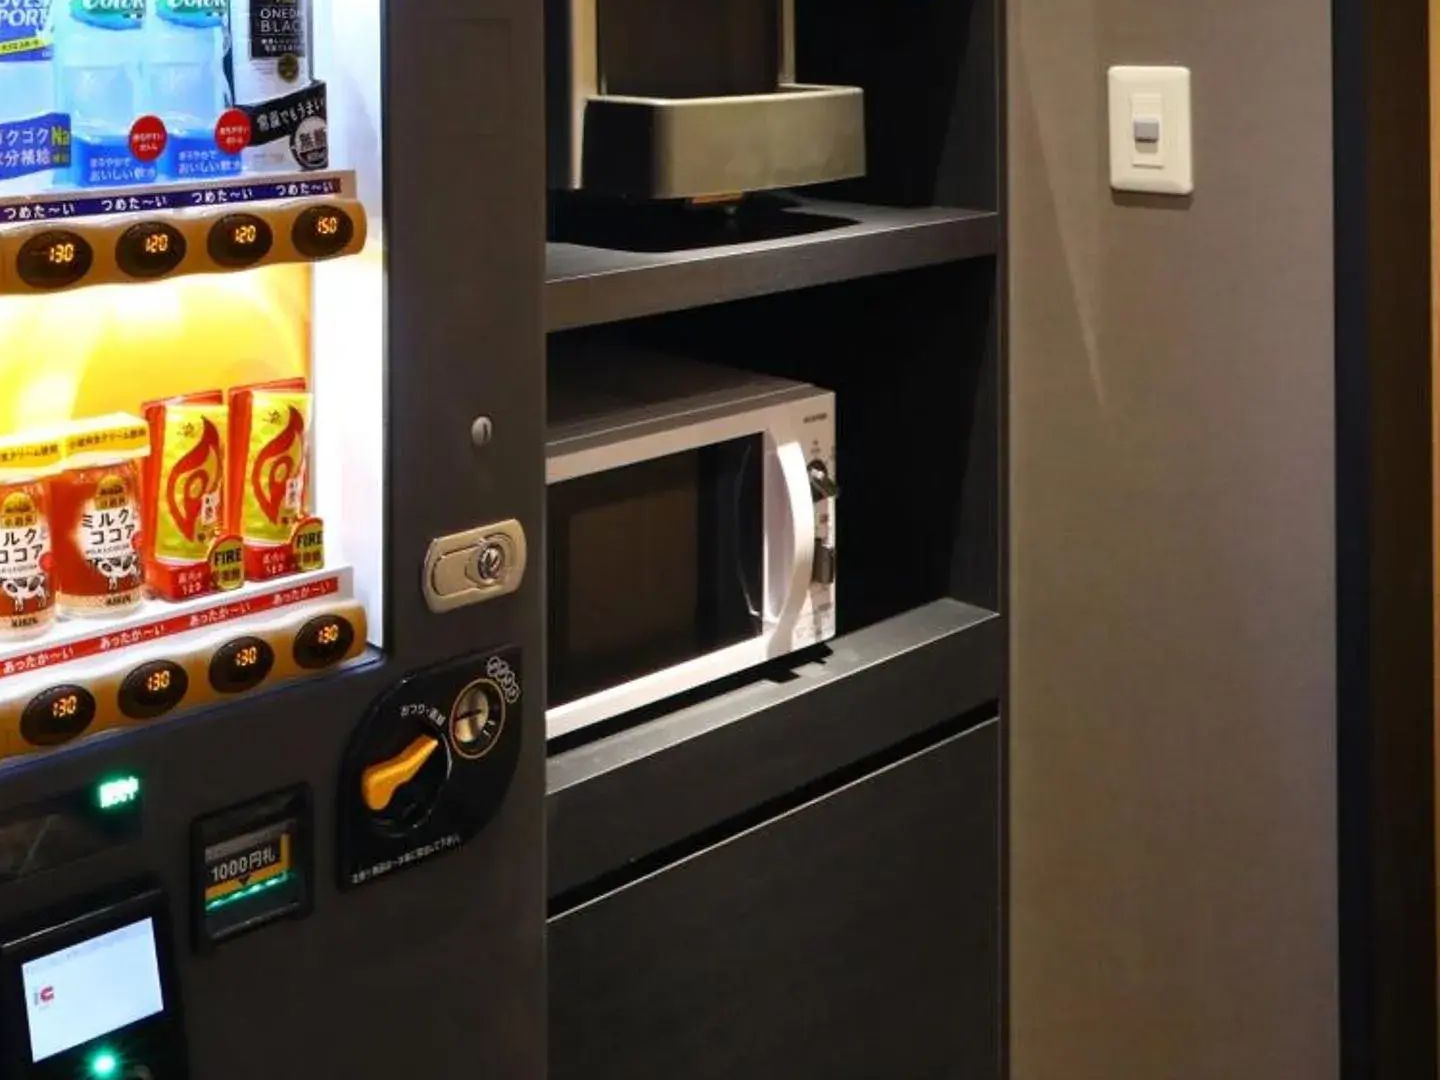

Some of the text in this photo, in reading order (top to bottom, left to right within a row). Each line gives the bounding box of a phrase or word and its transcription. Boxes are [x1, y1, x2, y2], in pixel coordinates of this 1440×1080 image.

[260, 21, 303, 34] BLAC
[233, 225, 256, 244] 120
[317, 216, 337, 236] 150
[49, 243, 74, 264] 130
[144, 233, 168, 254] 120
[296, 531, 323, 548] FIRE
[214, 548, 242, 565] FIRE
[317, 624, 340, 645] 130
[234, 646, 257, 668] 130
[146, 671, 171, 692] 130
[52, 694, 78, 719] 130
[211, 846, 276, 882] 1000円札
